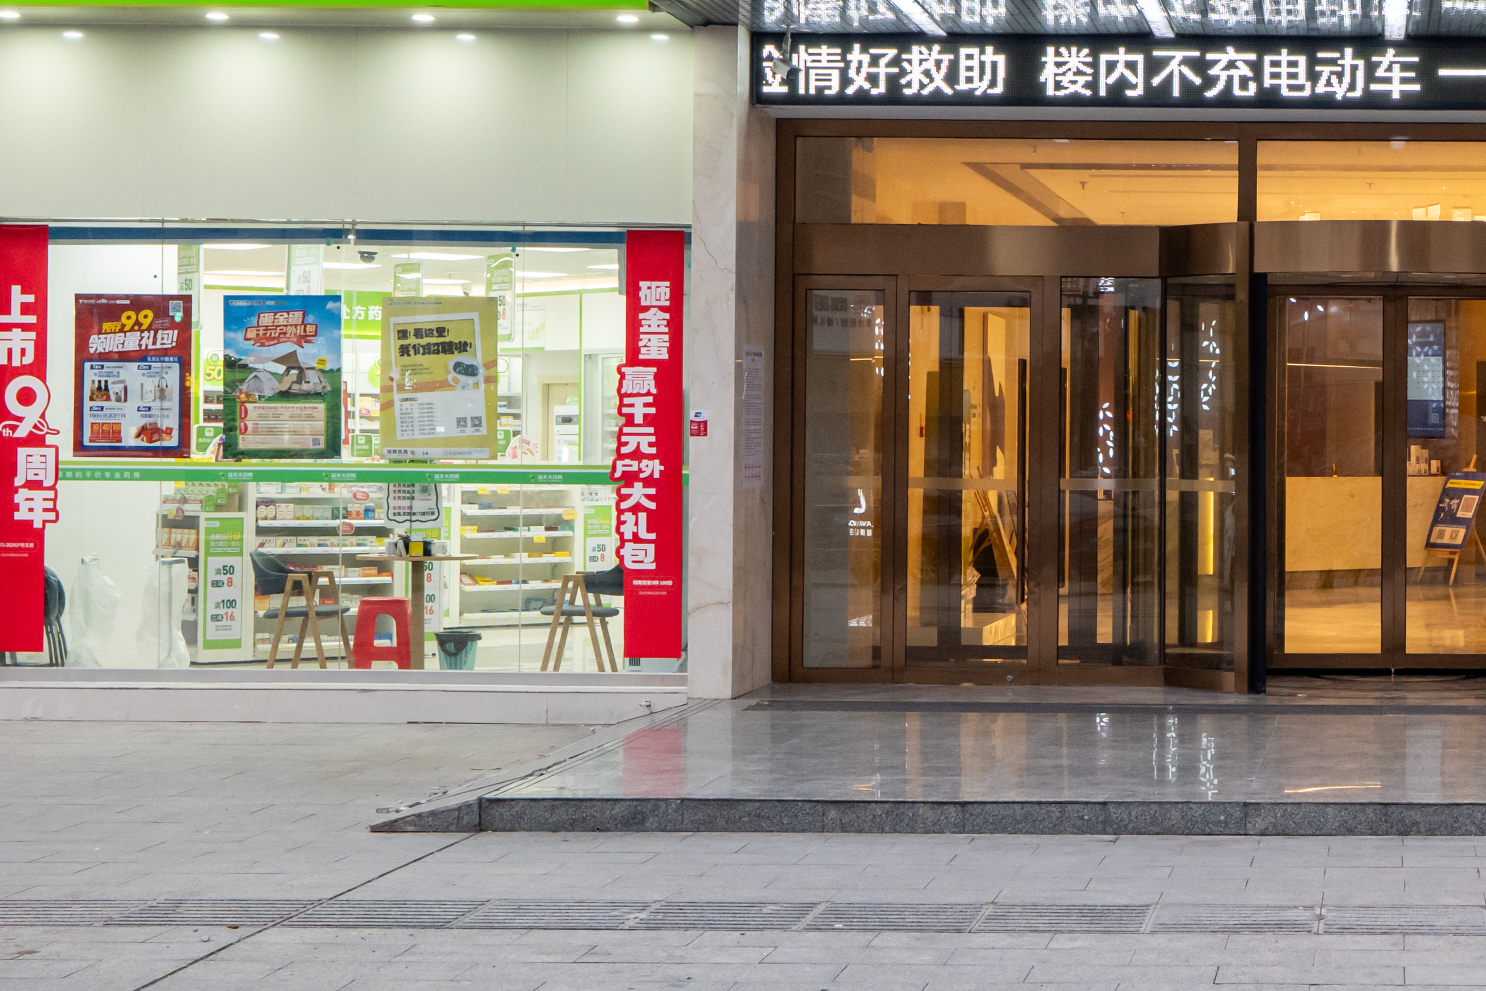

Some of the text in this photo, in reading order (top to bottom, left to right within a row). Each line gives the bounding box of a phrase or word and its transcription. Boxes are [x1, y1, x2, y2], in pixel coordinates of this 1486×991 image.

[1040, 45, 1421, 99] 楼内不充电动车
[258, 311, 304, 326] 砸金蛋
